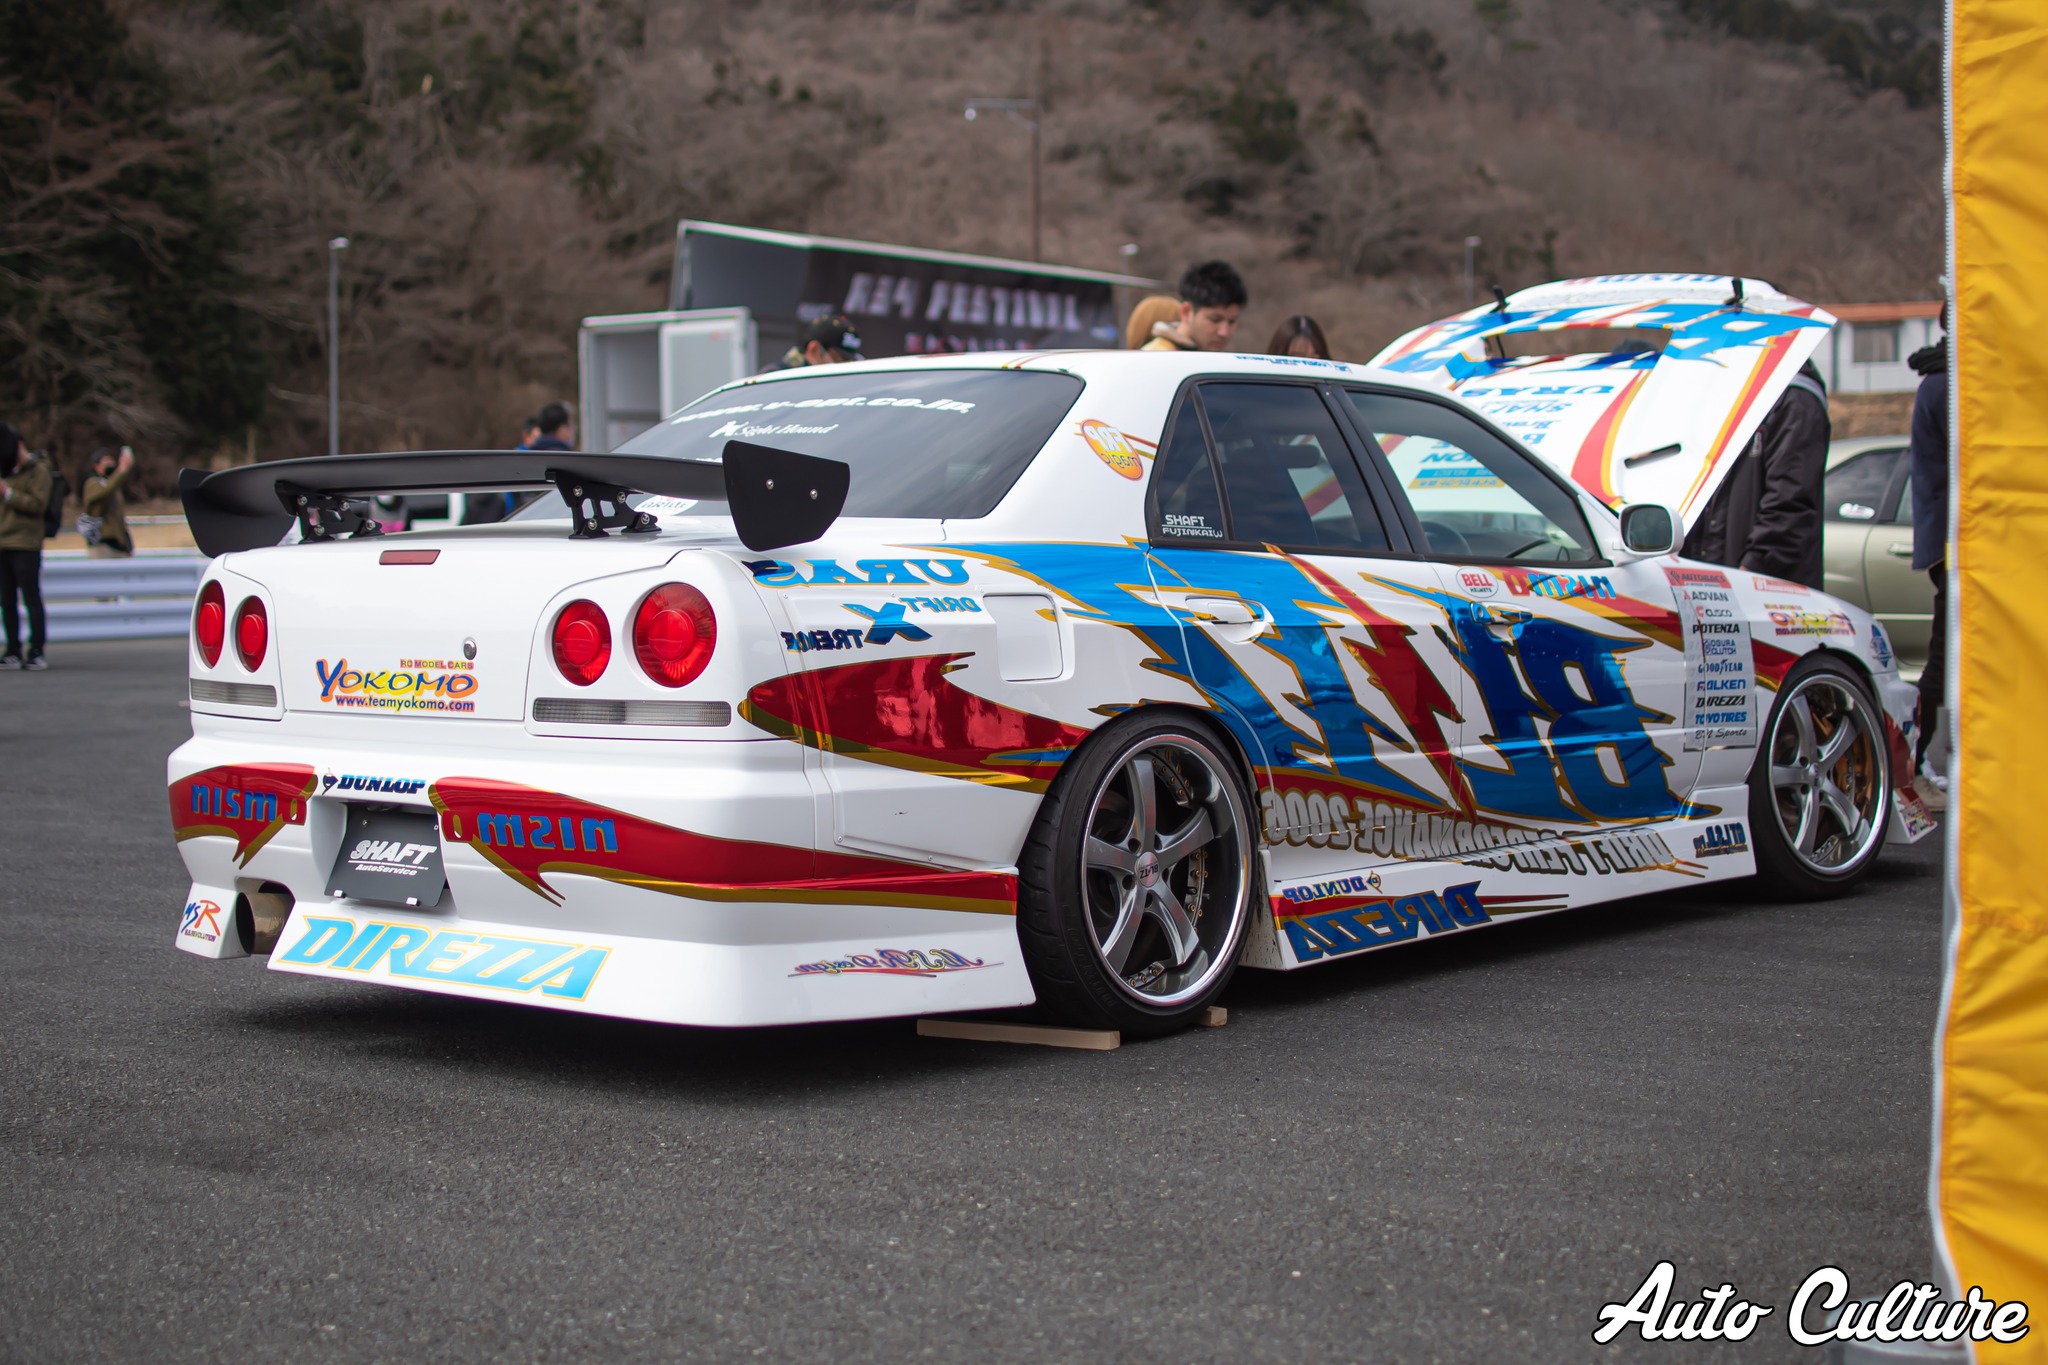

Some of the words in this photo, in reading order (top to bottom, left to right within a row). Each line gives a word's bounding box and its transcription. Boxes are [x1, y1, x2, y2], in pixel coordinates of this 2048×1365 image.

[1165, 514, 1205, 527] SHAFT
[1461, 573, 1493, 588] BELL
[1691, 590, 1729, 602] ADVAN
[1692, 622, 1741, 634] POTENZA
[400, 658, 413, 669] RC
[414, 660, 446, 670] MODEL
[447, 660, 475, 670] CARS
[315, 657, 479, 703] YOKOMO
[1696, 679, 1746, 692] FALKEN
[335, 694, 476, 713] www.teamyokomo.com
[1695, 694, 1746, 708] DIREZZA
[1695, 711, 1720, 725] TOYO
[1720, 710, 1747, 723] TIRES
[1715, 727, 1747, 739] Sports
[337, 774, 426, 794] DUNLOP
[349, 839, 438, 865] SHAFT
[354, 863, 418, 877] AutoService
[275, 915, 614, 1003] DIREZZA
